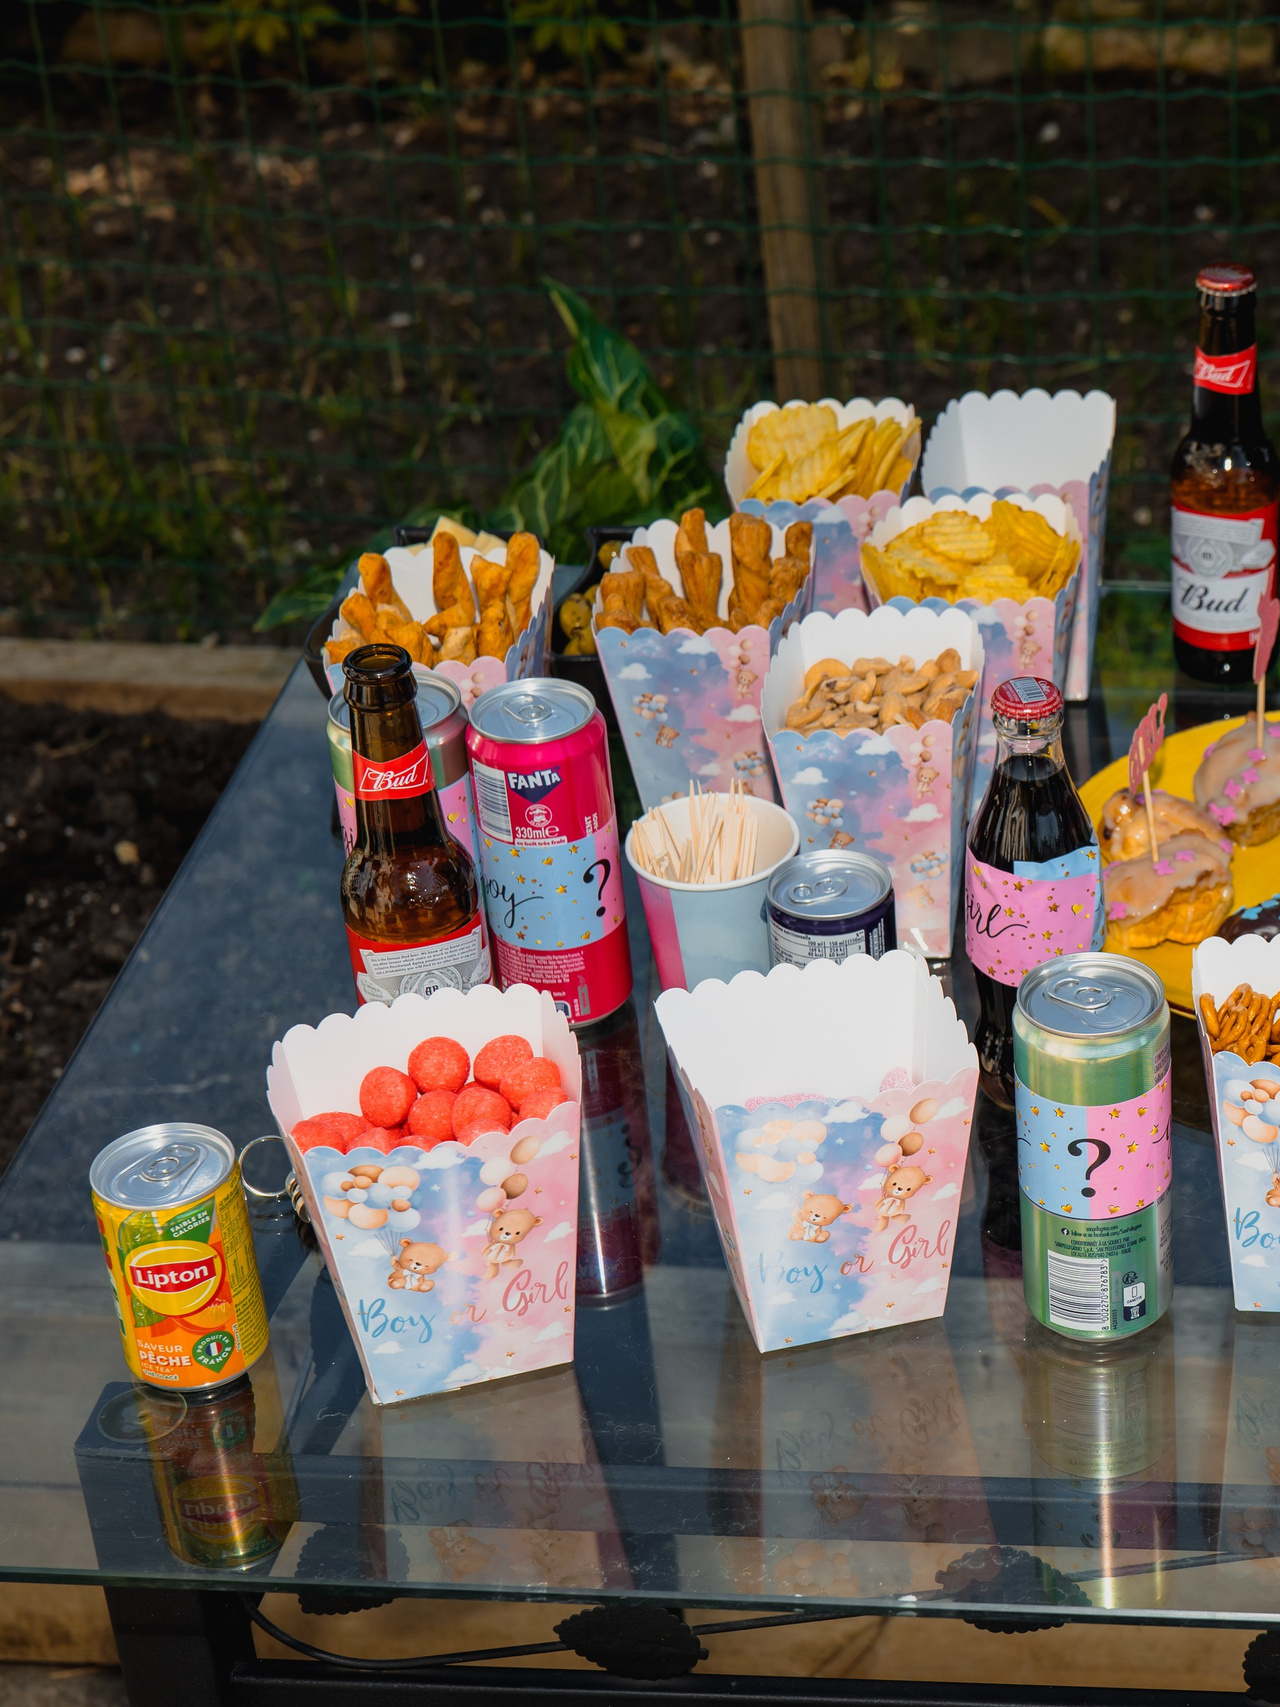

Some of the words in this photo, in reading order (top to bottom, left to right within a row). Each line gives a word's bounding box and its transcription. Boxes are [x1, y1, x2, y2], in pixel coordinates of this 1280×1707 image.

[1181, 583, 1250, 613] Bud
[368, 765, 418, 791] Bud
[507, 768, 562, 790] FANTA
[583, 858, 612, 918] ?
[1067, 1138, 1112, 1198] ?
[170, 1215, 197, 1233] FAIBLE
[198, 1210, 208, 1220] EN
[172, 1216, 212, 1239] CALORIES
[758, 1251, 829, 1294] Boy
[840, 1253, 875, 1276] or
[888, 1219, 952, 1270] Girl
[135, 1264, 209, 1289] Lipton
[1100, 1266, 1108, 1292] 876783
[360, 1297, 437, 1344] Boy
[449, 1302, 488, 1326] or
[502, 1260, 569, 1317] Girl
[1100, 1295, 1110, 1322] 002270
[137, 1338, 184, 1354] SAVEUR
[197, 1334, 222, 1353] PRODUIT
[223, 1335, 230, 1344] EN
[198, 1346, 232, 1366] FRANCE
[139, 1349, 192, 1367] PÊCHE
